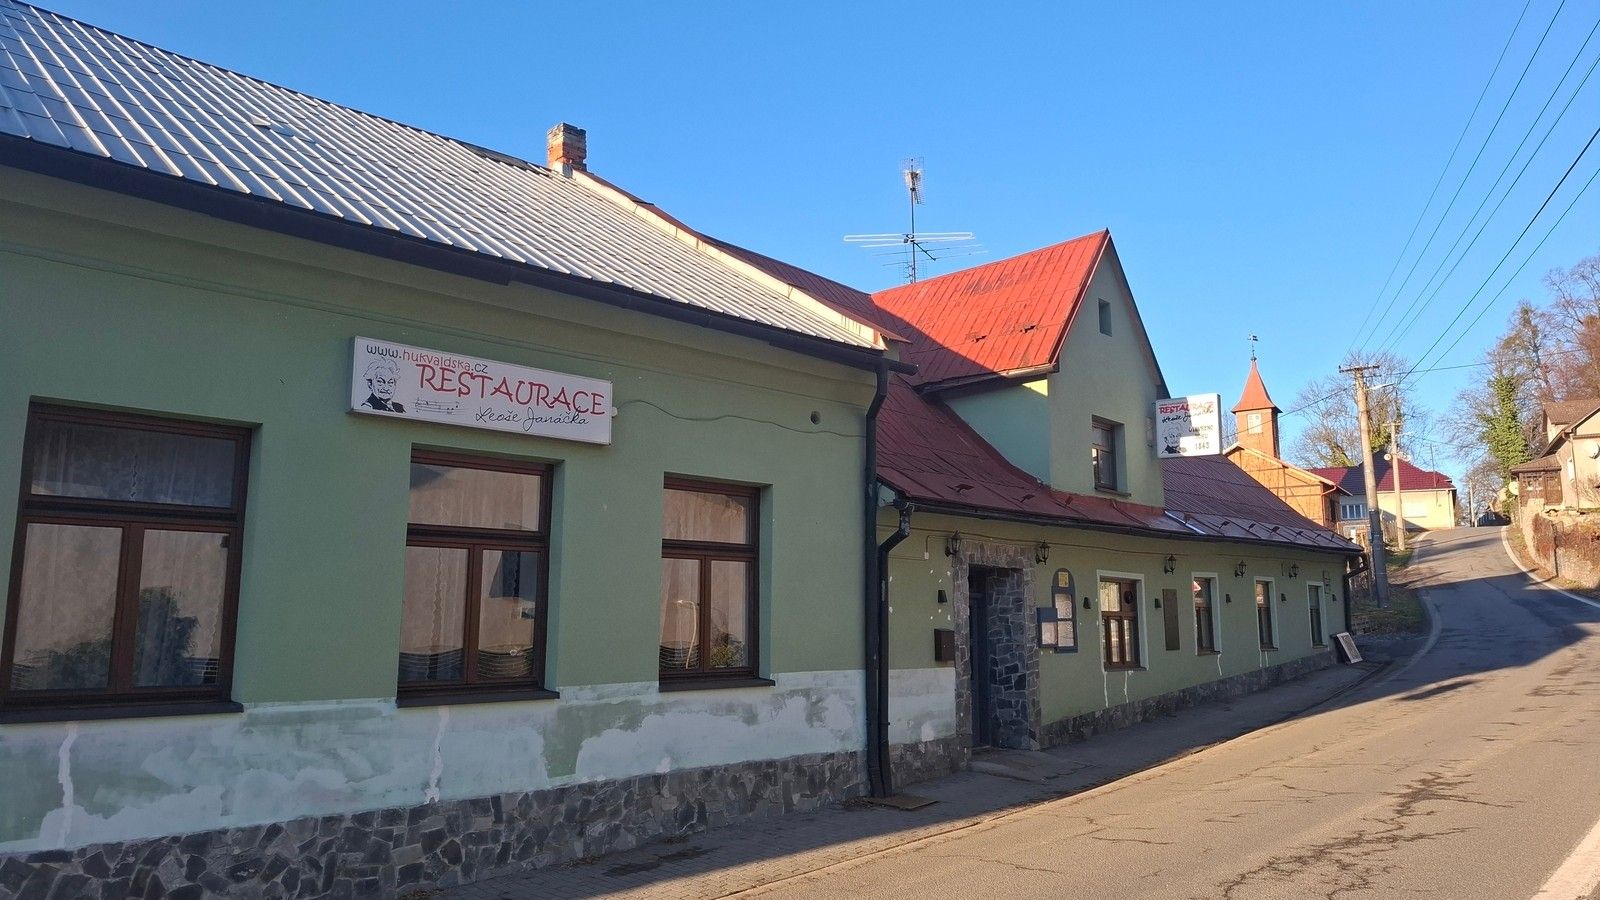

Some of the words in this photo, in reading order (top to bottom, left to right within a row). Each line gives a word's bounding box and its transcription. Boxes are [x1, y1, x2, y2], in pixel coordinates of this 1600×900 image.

[366, 344, 488, 374] www.hukvaldska.cz
[416, 364, 605, 415] RESTAURACE
[475, 406, 522, 424] Leoše
[522, 406, 589, 431] Janáčka
